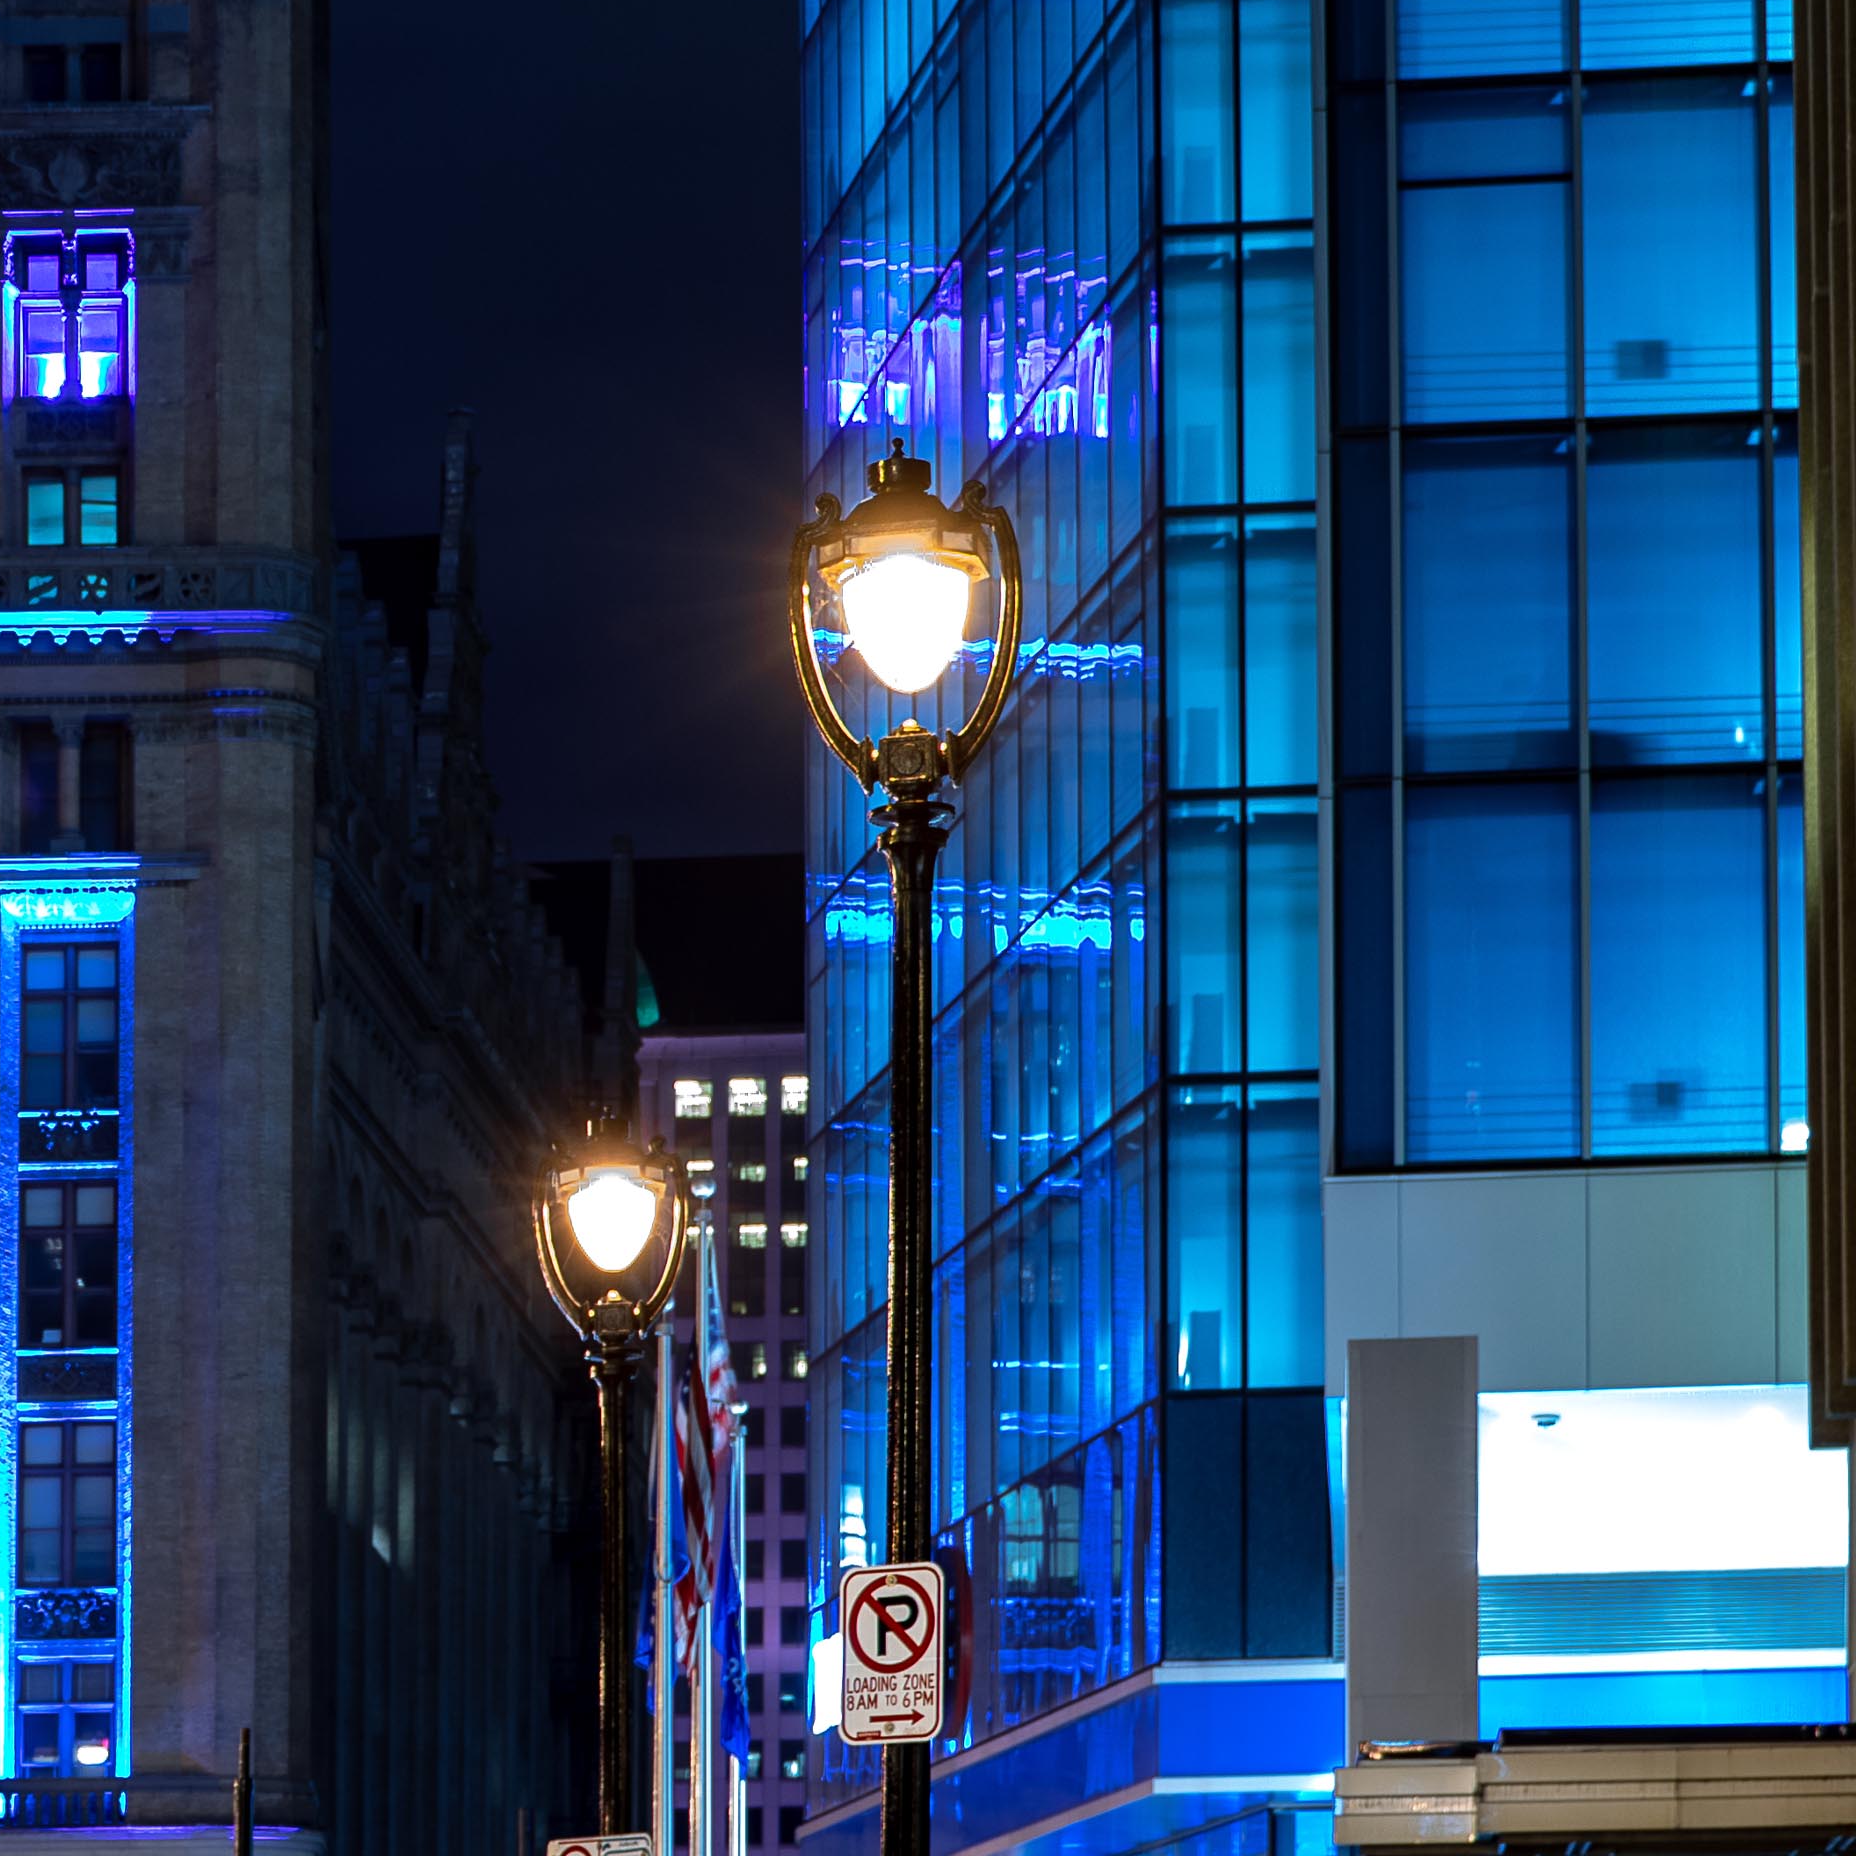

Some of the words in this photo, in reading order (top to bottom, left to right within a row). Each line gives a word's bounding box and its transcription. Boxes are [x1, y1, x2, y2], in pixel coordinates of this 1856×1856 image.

[847, 1676, 897, 1694] LOADING
[903, 1673, 935, 1691] ZONE
[886, 1694, 897, 1706] TO
